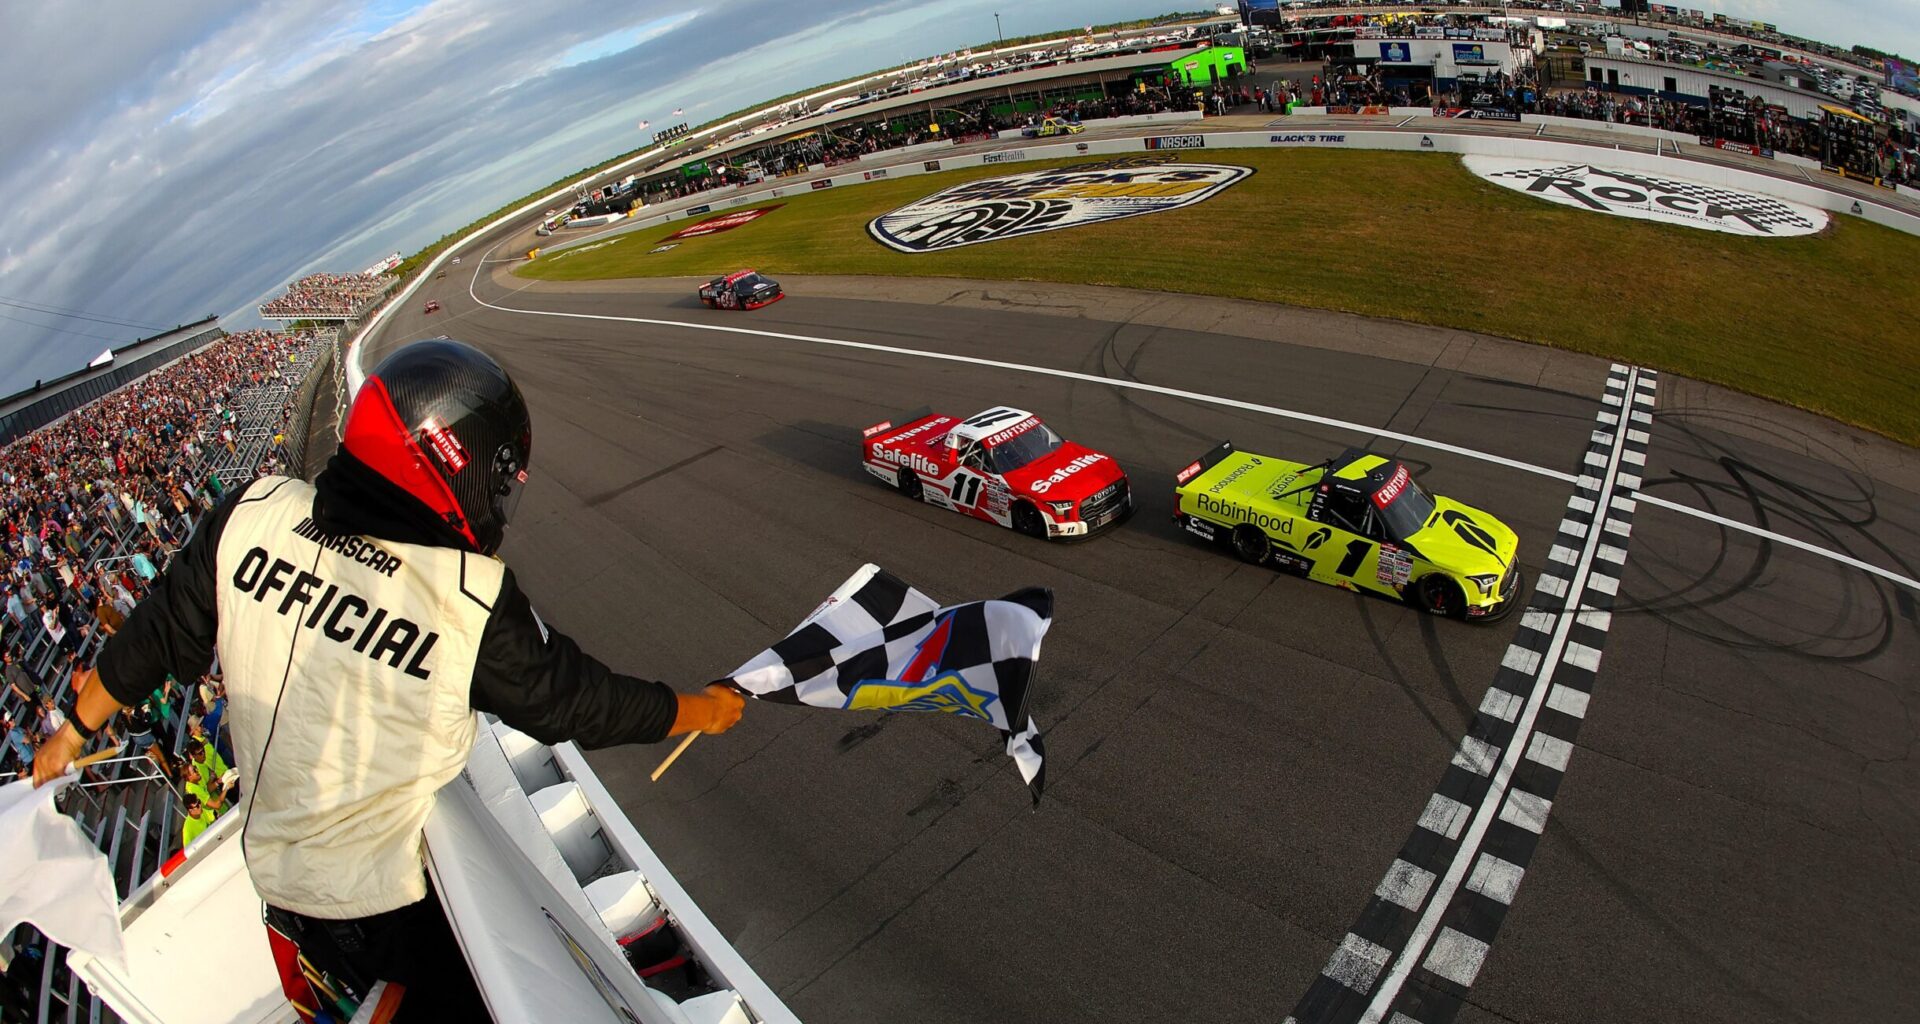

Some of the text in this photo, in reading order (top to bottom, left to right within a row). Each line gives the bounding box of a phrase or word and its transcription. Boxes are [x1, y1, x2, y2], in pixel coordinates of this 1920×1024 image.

[1160, 135, 1203, 149] NASCAR
[1270, 135, 1316, 143] BLACK'S
[983, 151, 1026, 164] FirstHealth
[1526, 175, 1775, 235] ROCK
[883, 417, 951, 444] Safelite
[987, 417, 1039, 446] CRAFTSMAN
[872, 442, 939, 476] Safelite
[1332, 454, 1390, 481] 1
[950, 472, 982, 506] 11
[1093, 485, 1117, 501] TOYOTA
[1209, 463, 1255, 494] Robinhood
[1269, 473, 1298, 495] TOYOTA
[1378, 464, 1409, 504] CRAFTSMAN
[1197, 493, 1294, 535] Robinhood
[1066, 526, 1076, 534] 11
[1185, 525, 1214, 541] SiriusXM
[316, 530, 402, 578] NASCAR
[1335, 539, 1374, 578] 1
[233, 546, 439, 680] OFFICIAL
